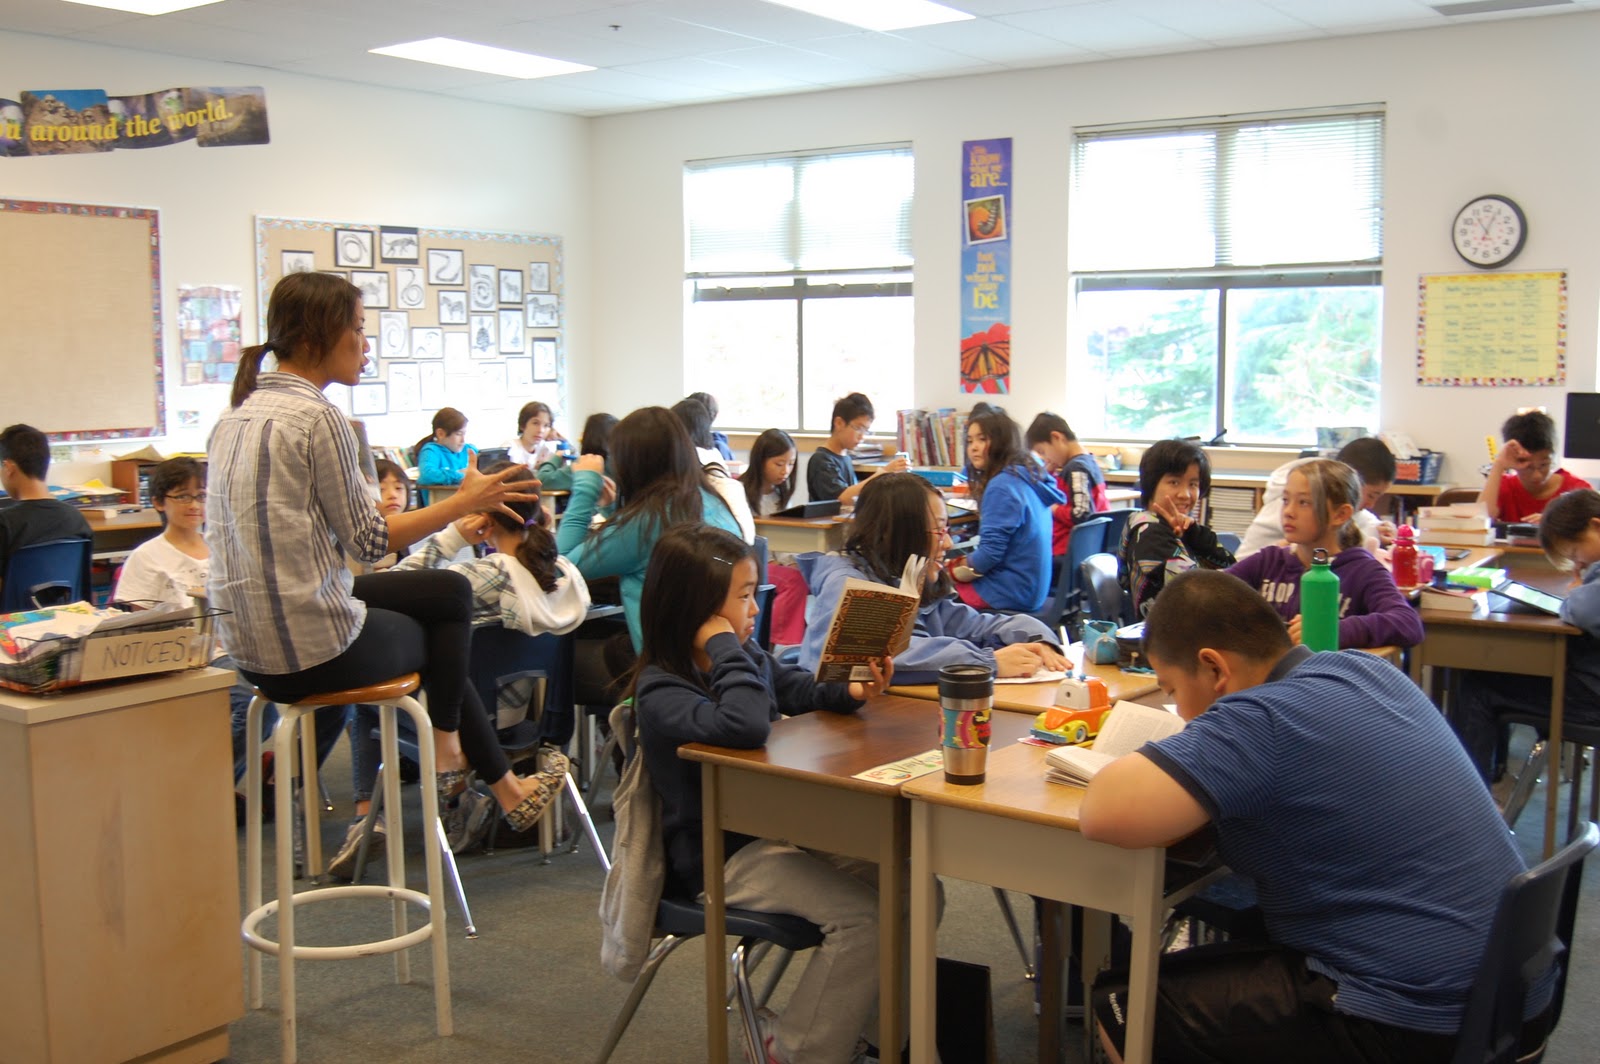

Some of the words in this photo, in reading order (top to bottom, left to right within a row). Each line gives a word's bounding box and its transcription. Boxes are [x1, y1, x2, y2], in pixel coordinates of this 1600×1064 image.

[30, 118, 119, 141] around
[125, 114, 161, 138] the
[1483, 204, 1493, 213] 12
[1463, 217, 1473, 226] 10
[1503, 216, 1511, 224] 2
[1460, 228, 1467, 236] 9
[1506, 226, 1514, 235] 3
[1472, 247, 1479, 255] 7
[1482, 250, 1490, 258] 6
[1493, 247, 1501, 255] 5
